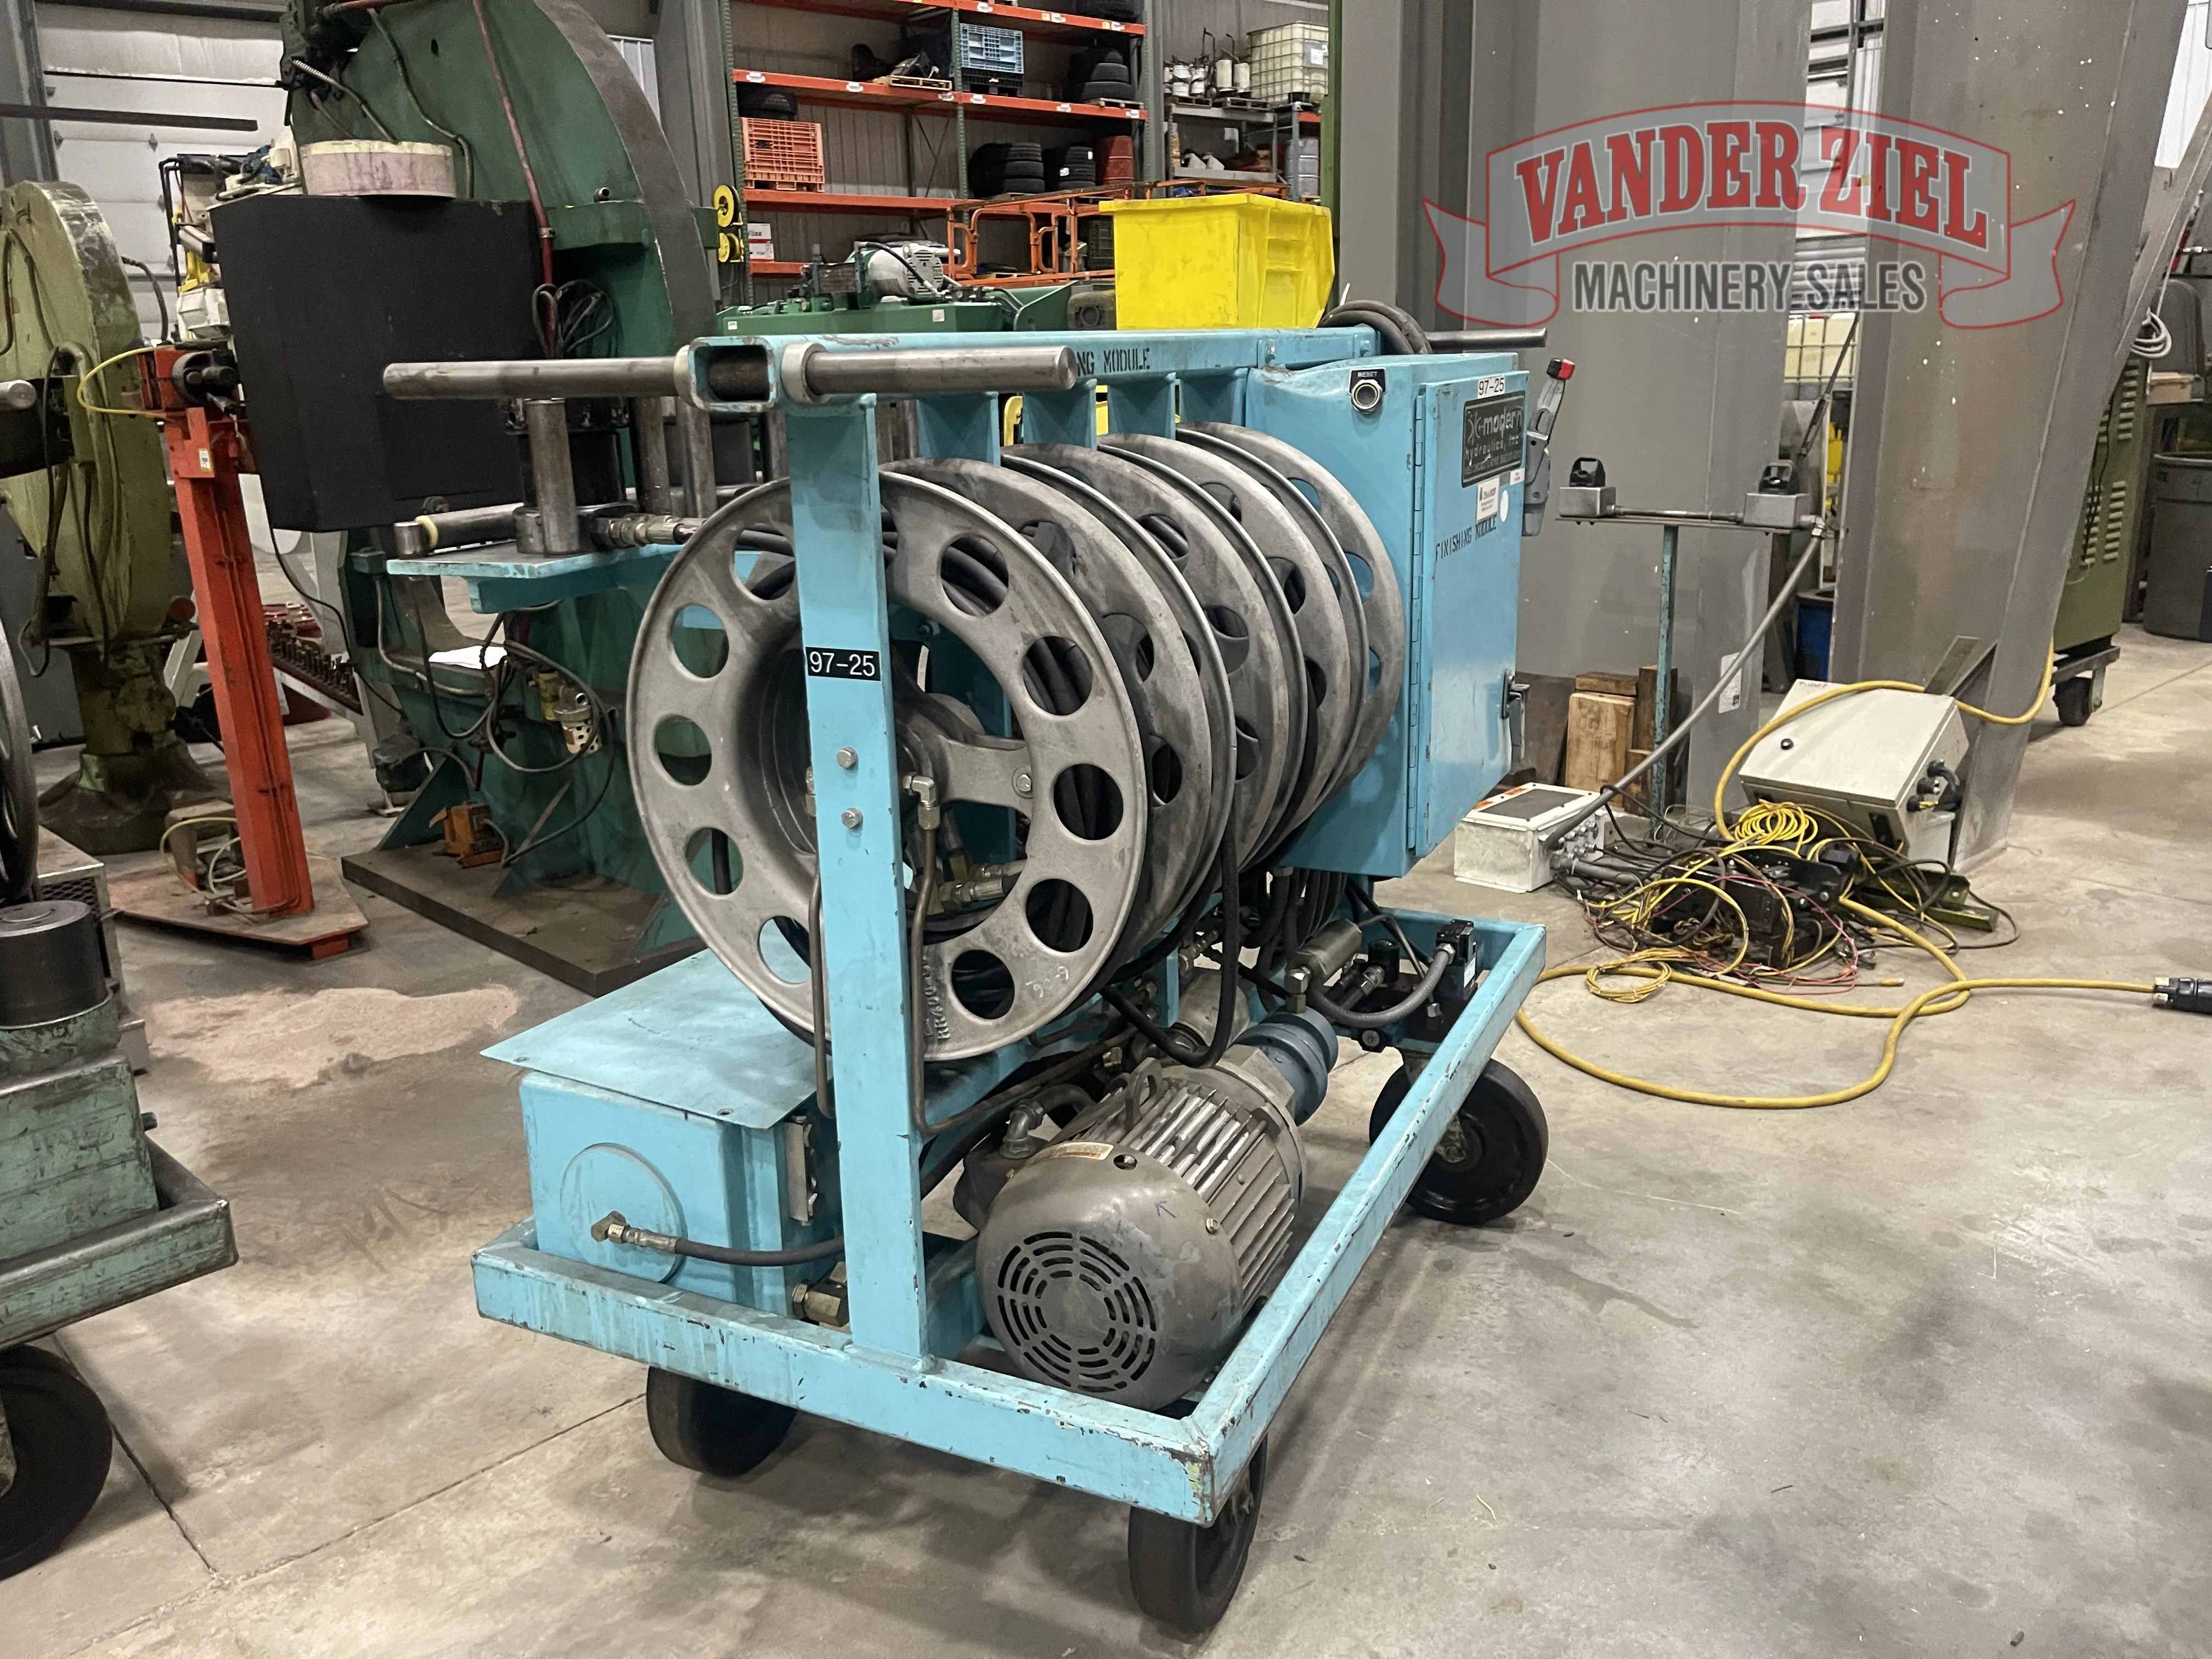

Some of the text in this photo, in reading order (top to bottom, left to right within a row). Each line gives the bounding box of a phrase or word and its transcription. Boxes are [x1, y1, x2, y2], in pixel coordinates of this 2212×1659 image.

[1076, 348, 1150, 376] NG MODULE
[1479, 378, 1504, 396] 97-25
[1435, 527, 1472, 562] FINISHING
[810, 651, 875, 676] 97-25
